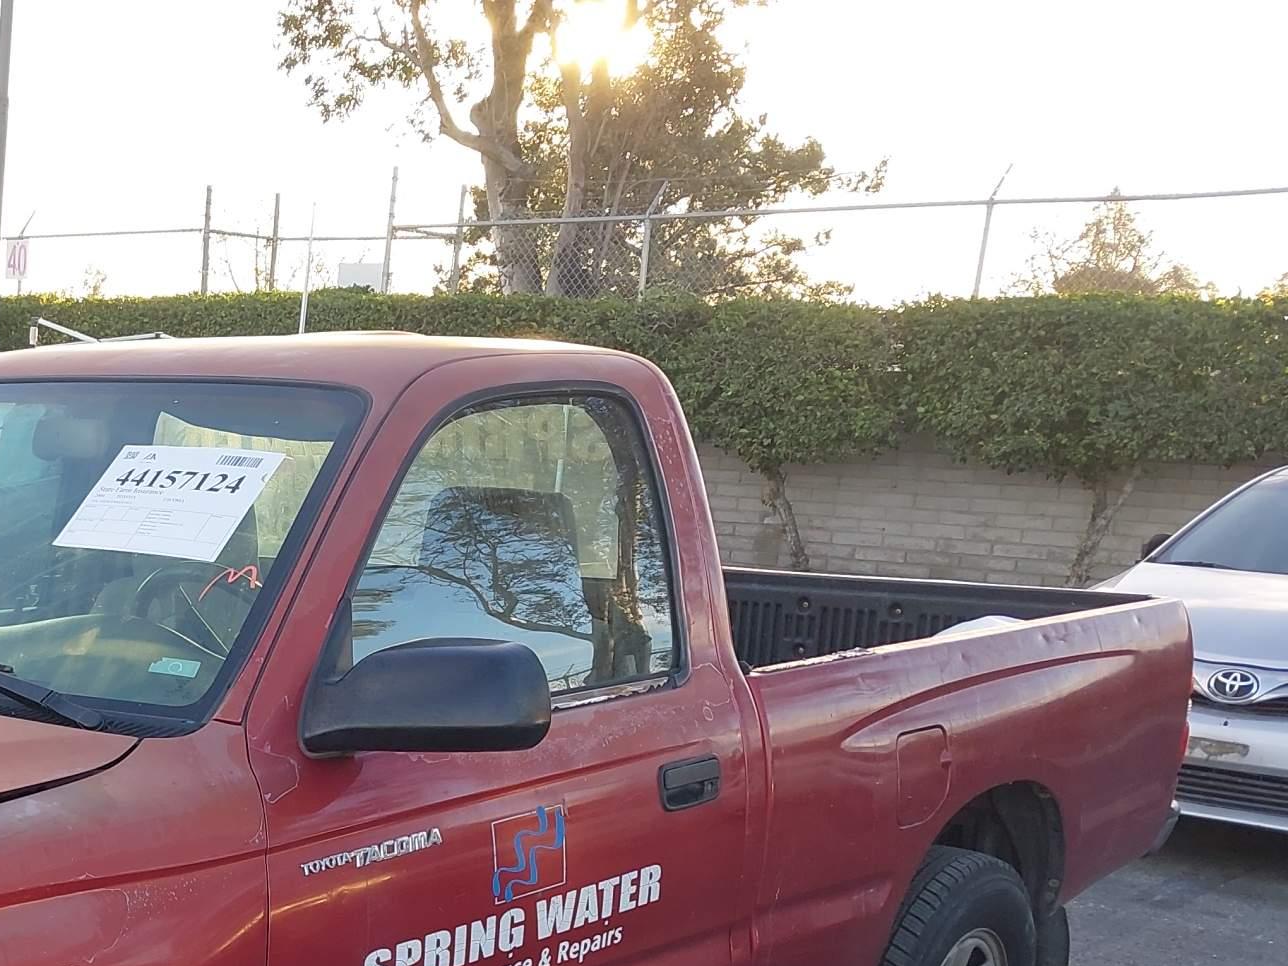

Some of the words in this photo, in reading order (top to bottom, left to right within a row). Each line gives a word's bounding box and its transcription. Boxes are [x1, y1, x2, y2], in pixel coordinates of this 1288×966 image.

[7, 244, 27, 276] 40
[116, 467, 247, 494] 44157124
[301, 851, 353, 876] TOYOTA
[353, 827, 443, 868] TACOMA
[536, 864, 662, 940] WATER
[557, 920, 623, 964] Repairs
